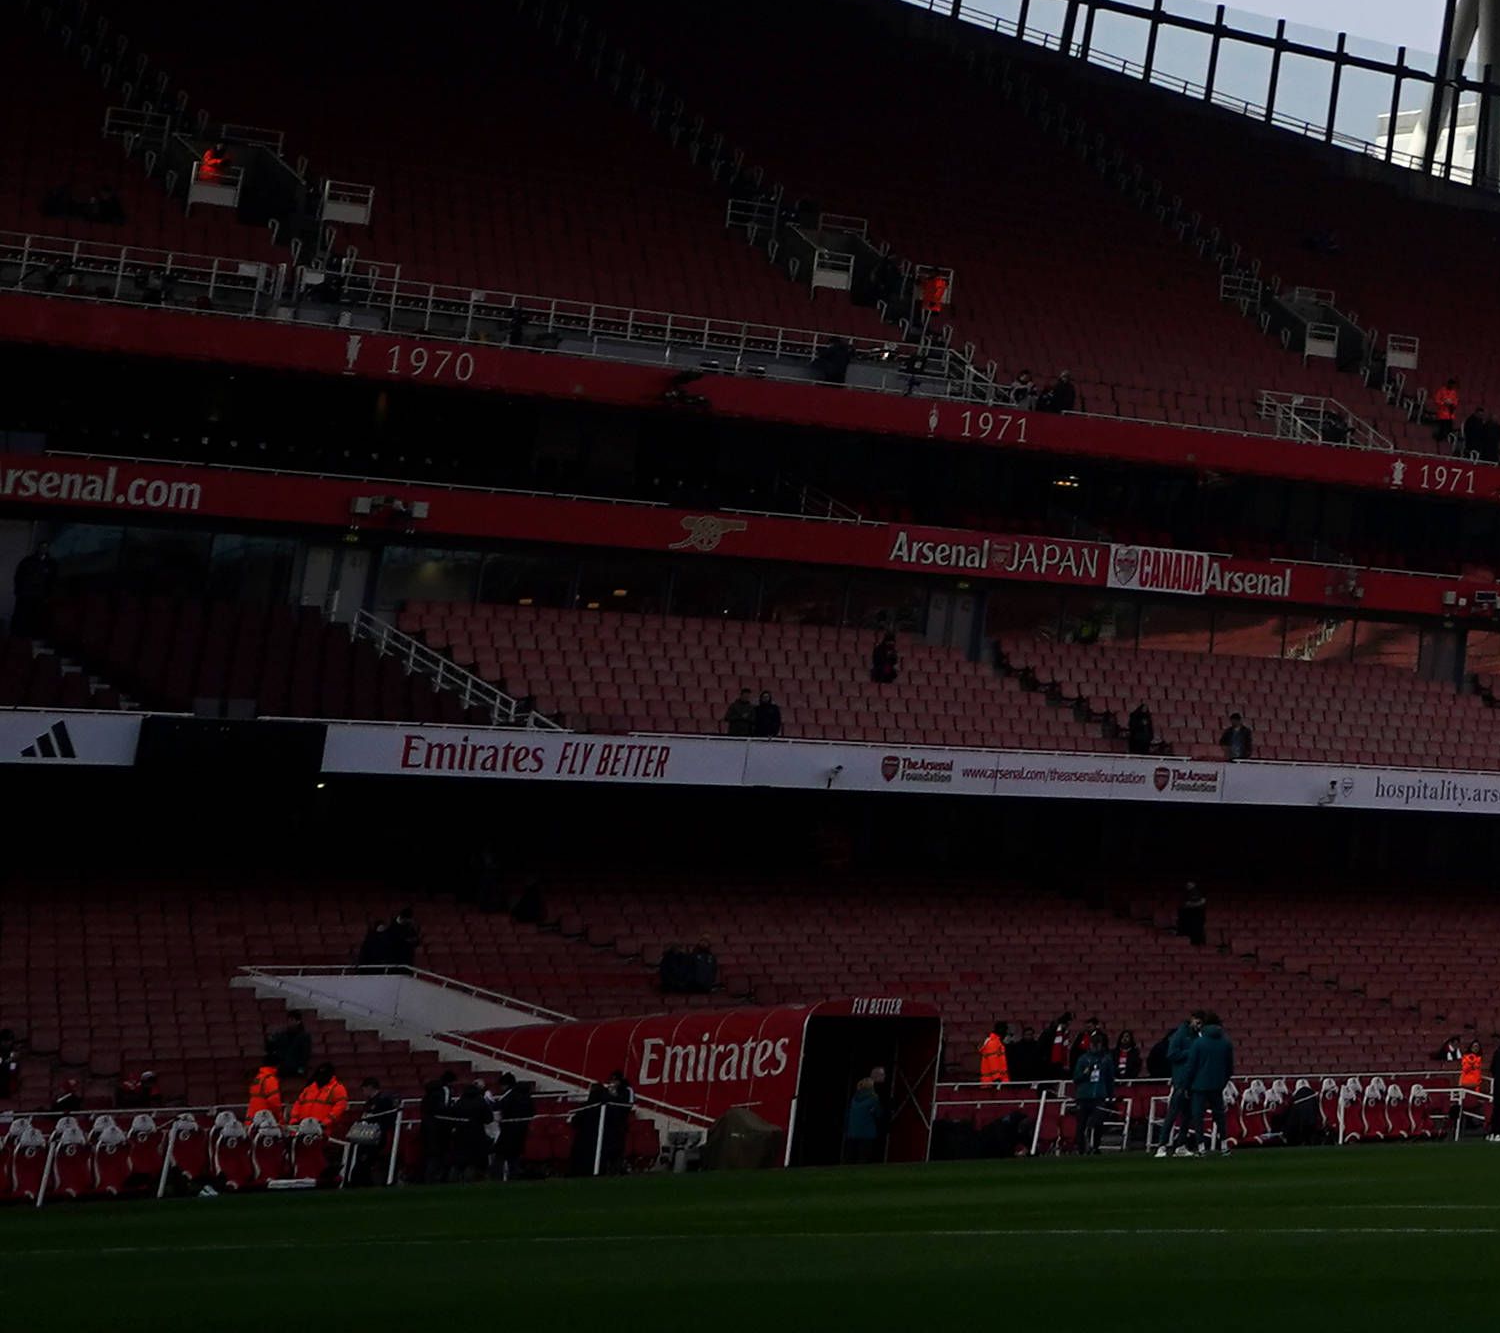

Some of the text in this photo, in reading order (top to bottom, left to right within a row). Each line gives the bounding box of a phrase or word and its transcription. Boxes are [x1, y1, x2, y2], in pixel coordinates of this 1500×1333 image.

[388, 345, 474, 381] 1970
[960, 410, 1028, 443] 1971
[0, 466, 202, 510] rsenal.com
[1420, 464, 1476, 494] 1971
[889, 531, 1100, 579] Arsenal JAPAN
[1139, 549, 1204, 593] CANADA
[1204, 562, 1291, 598] Arsenal
[401, 735, 671, 777] Emirates FLY BETTER
[902, 757, 954, 772] The Arsenal
[901, 771, 952, 784] Foundation
[962, 765, 1146, 785] www.arsenal.com/thearsenalfoundation
[1171, 781, 1217, 793] Foundation
[1172, 769, 1218, 782] The Arsenal
[852, 997, 903, 1014] FLY BETTER
[639, 1032, 790, 1085] Emirates
